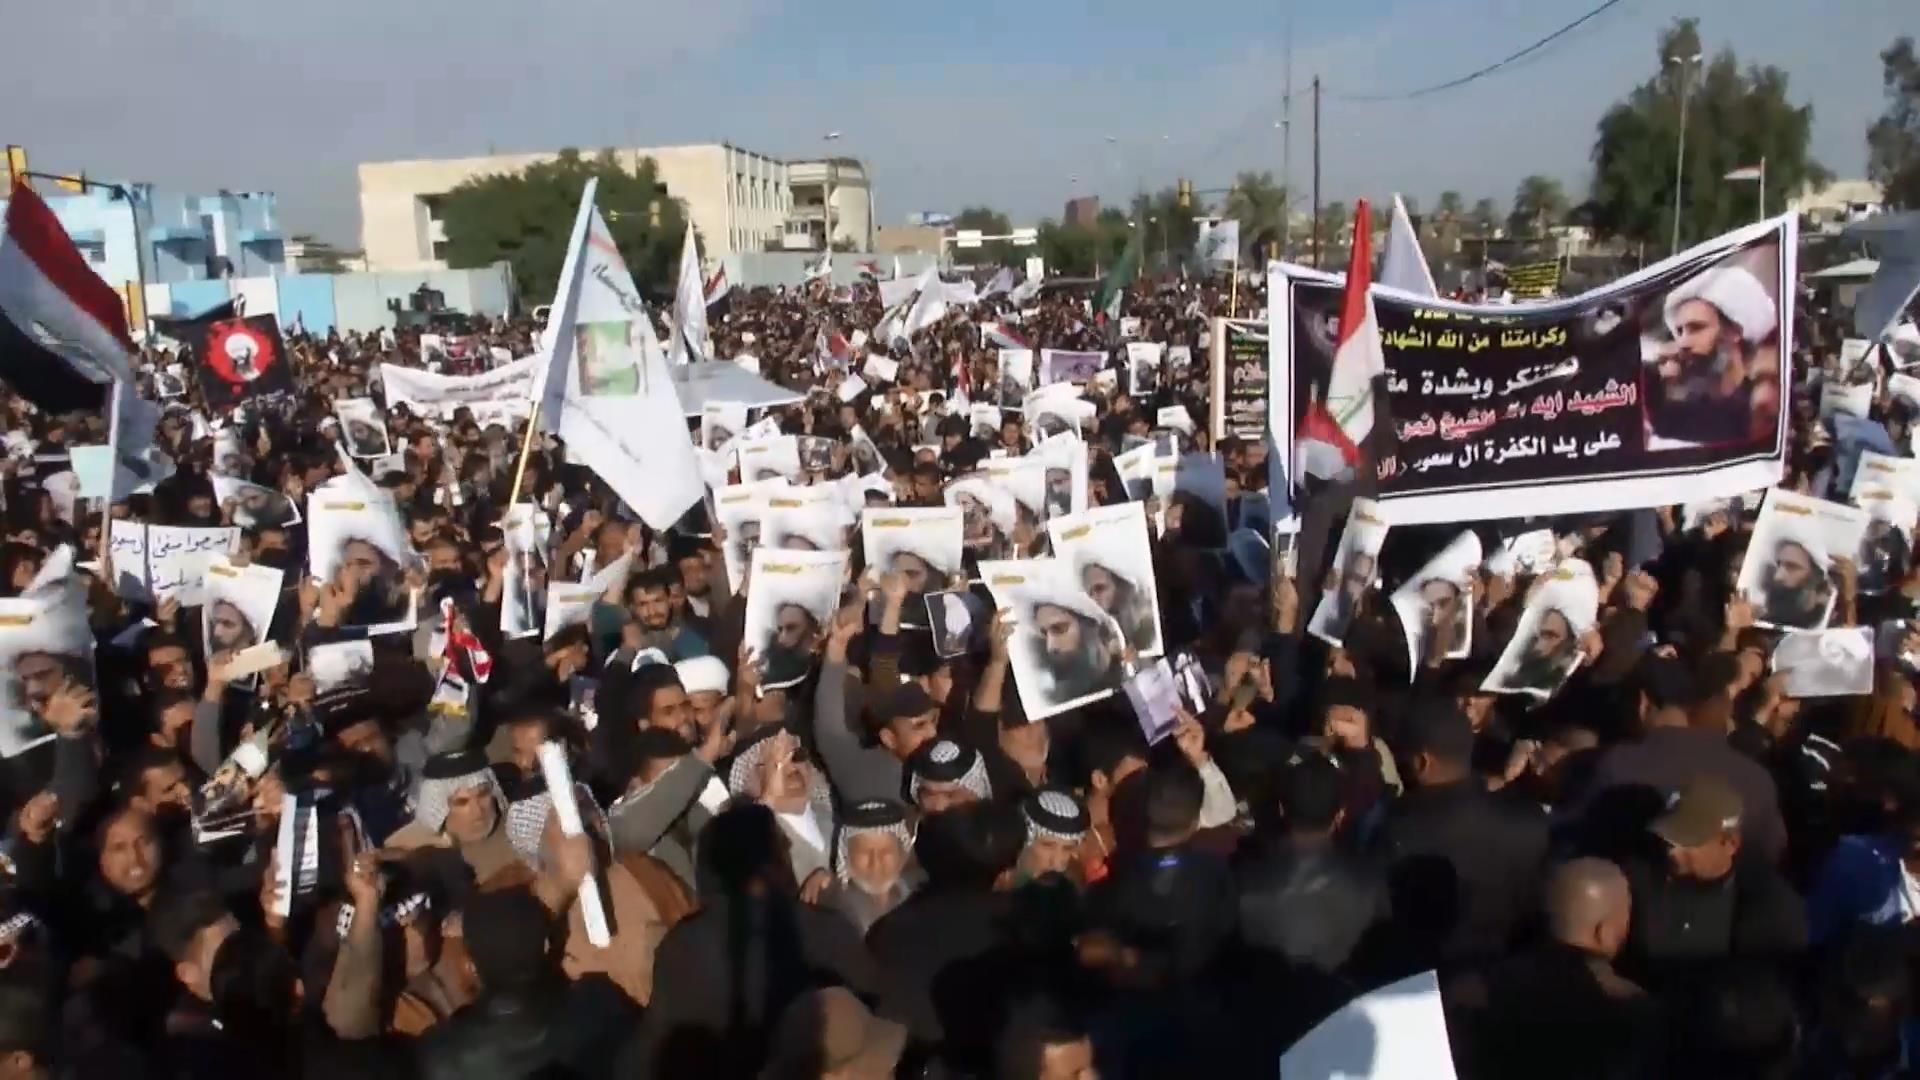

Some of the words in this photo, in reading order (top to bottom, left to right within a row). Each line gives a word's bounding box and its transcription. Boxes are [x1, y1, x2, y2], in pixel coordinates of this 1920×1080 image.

[1436, 328, 1464, 348] الله
[1467, 333, 1491, 353] من
[1501, 325, 1567, 348] وكرامتنا
[1421, 366, 1493, 400] وبشدة
[1567, 378, 1638, 416] الشهيد
[1439, 408, 1497, 441] الشيخ
[1458, 442, 1480, 468] ال
[1484, 434, 1546, 465] الكفرة
[1552, 434, 1577, 456] يد
[1584, 431, 1622, 456] على
